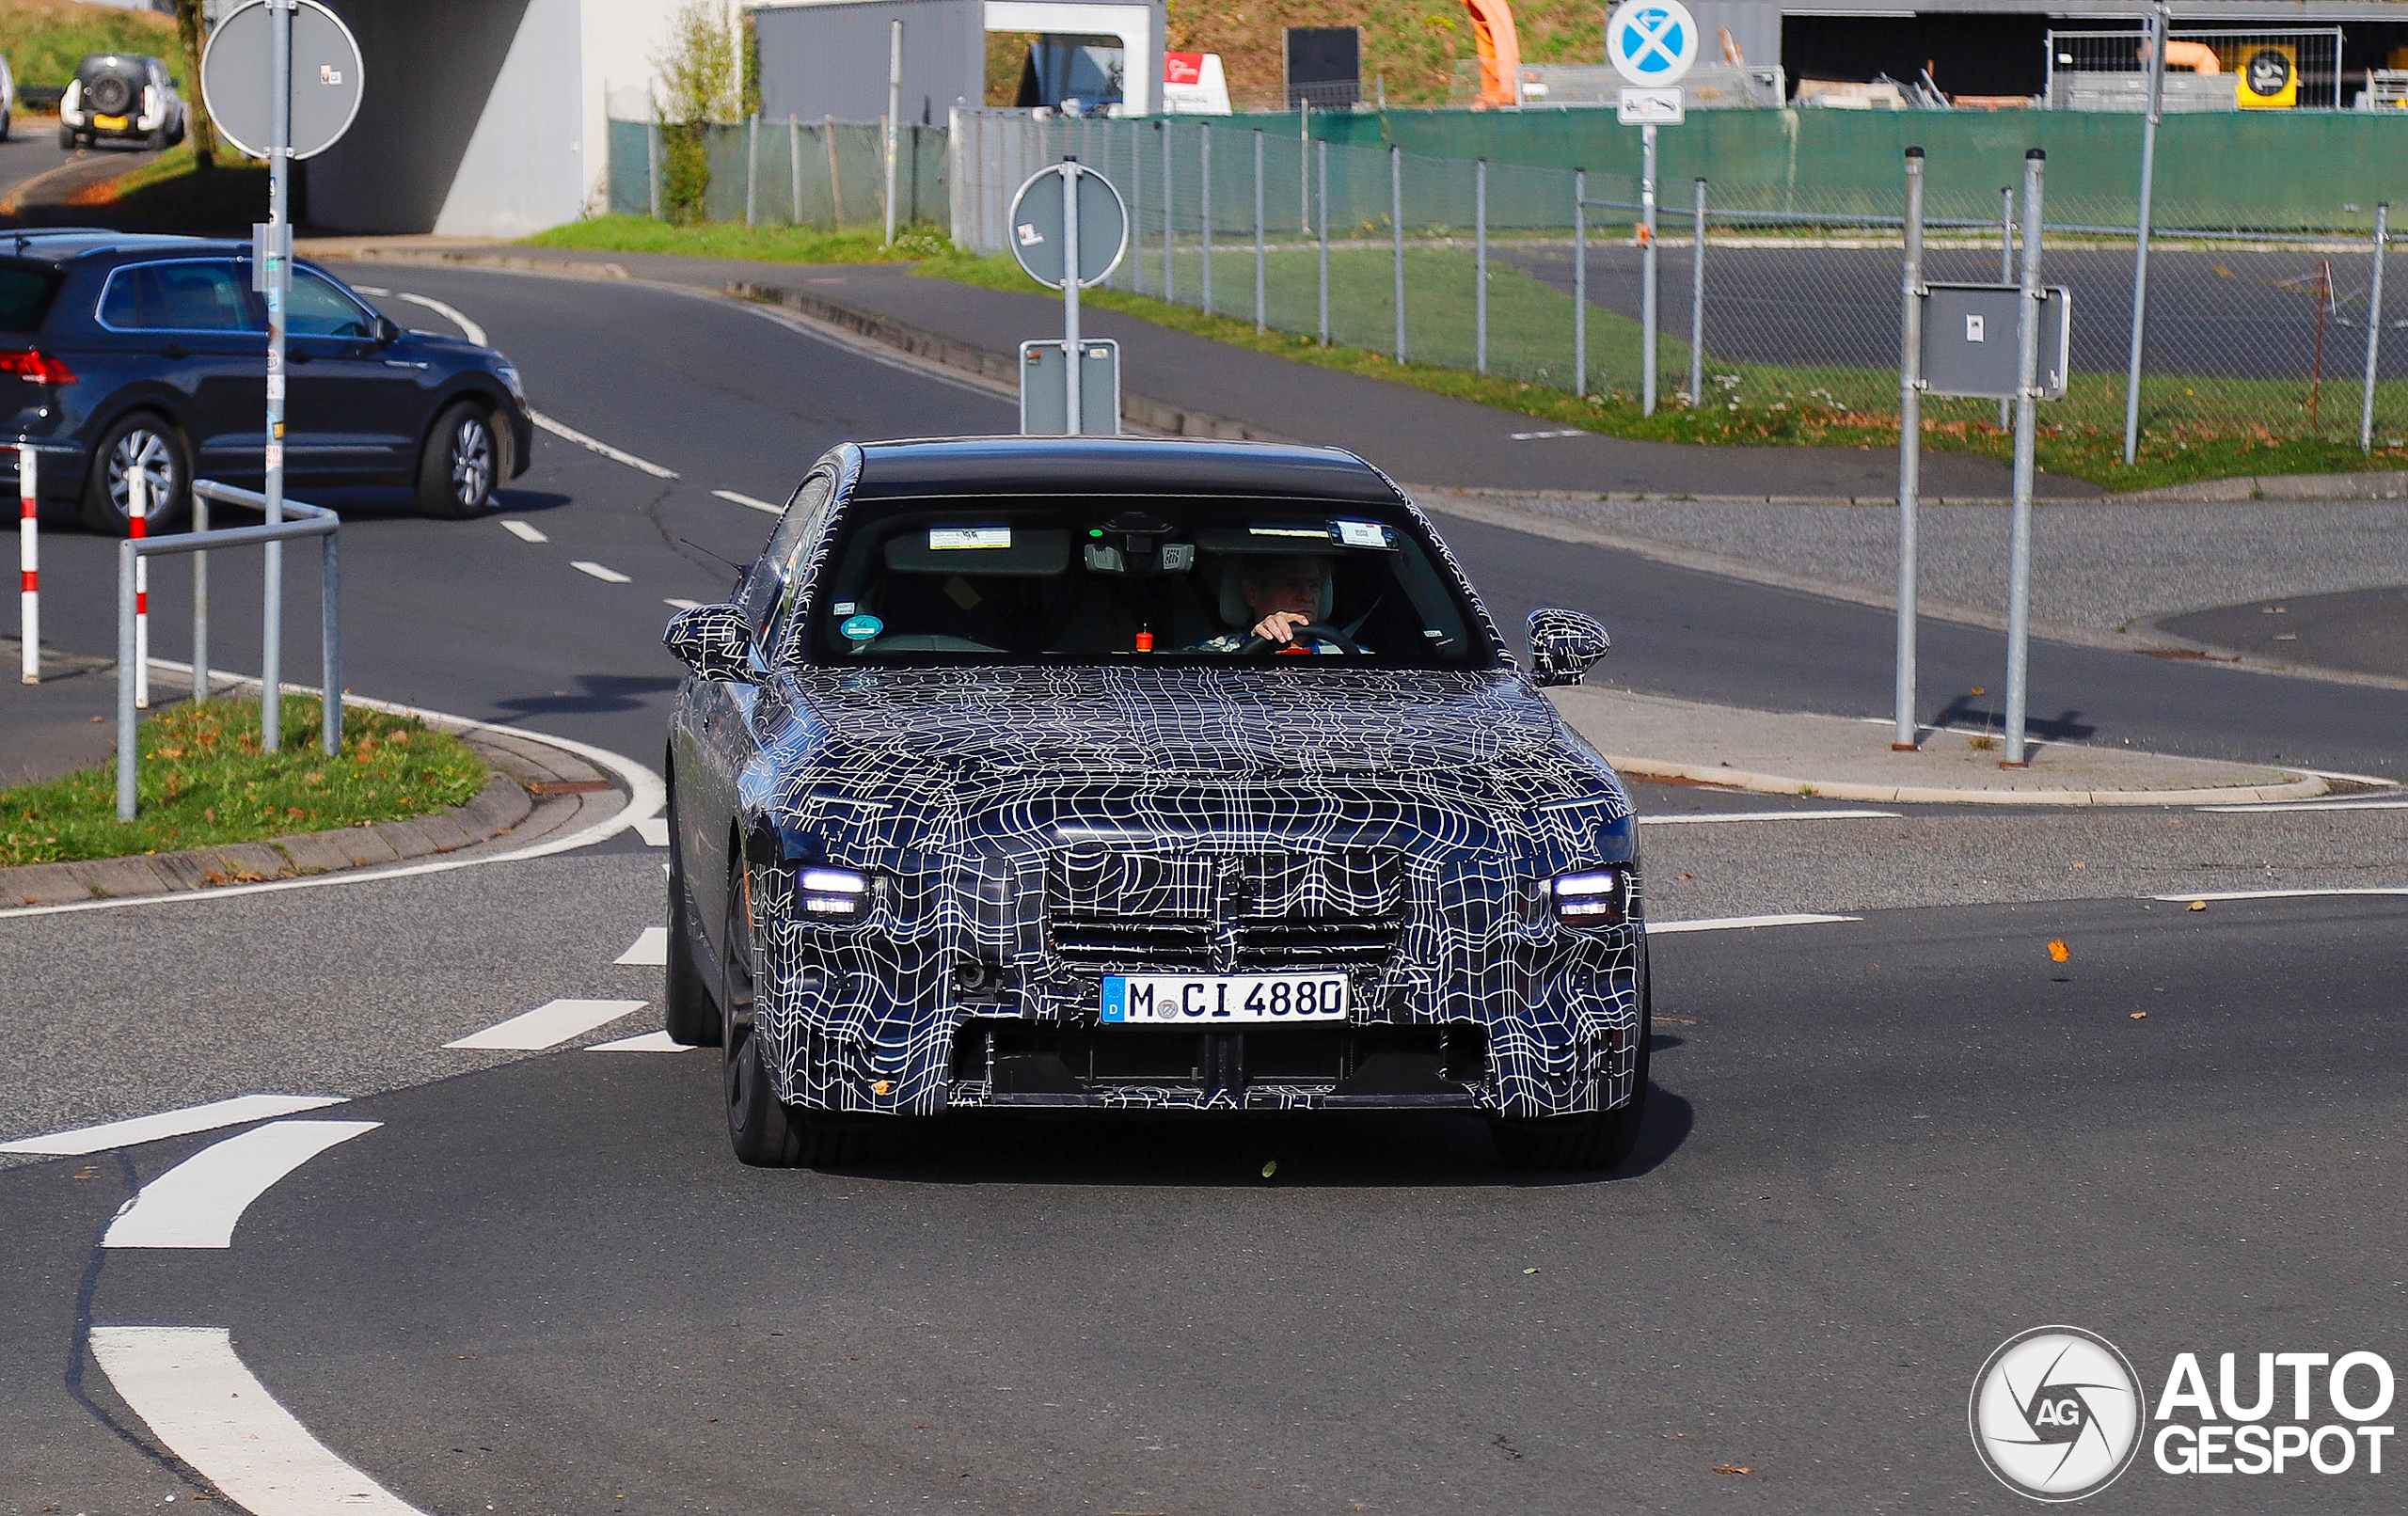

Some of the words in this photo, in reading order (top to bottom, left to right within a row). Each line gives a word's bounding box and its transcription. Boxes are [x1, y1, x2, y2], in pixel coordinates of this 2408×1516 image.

[1108, 1003, 1118, 1015] D
[1130, 983, 1154, 1017] M
[1182, 983, 1231, 1017] CI
[1244, 981, 1342, 1017] 4880
